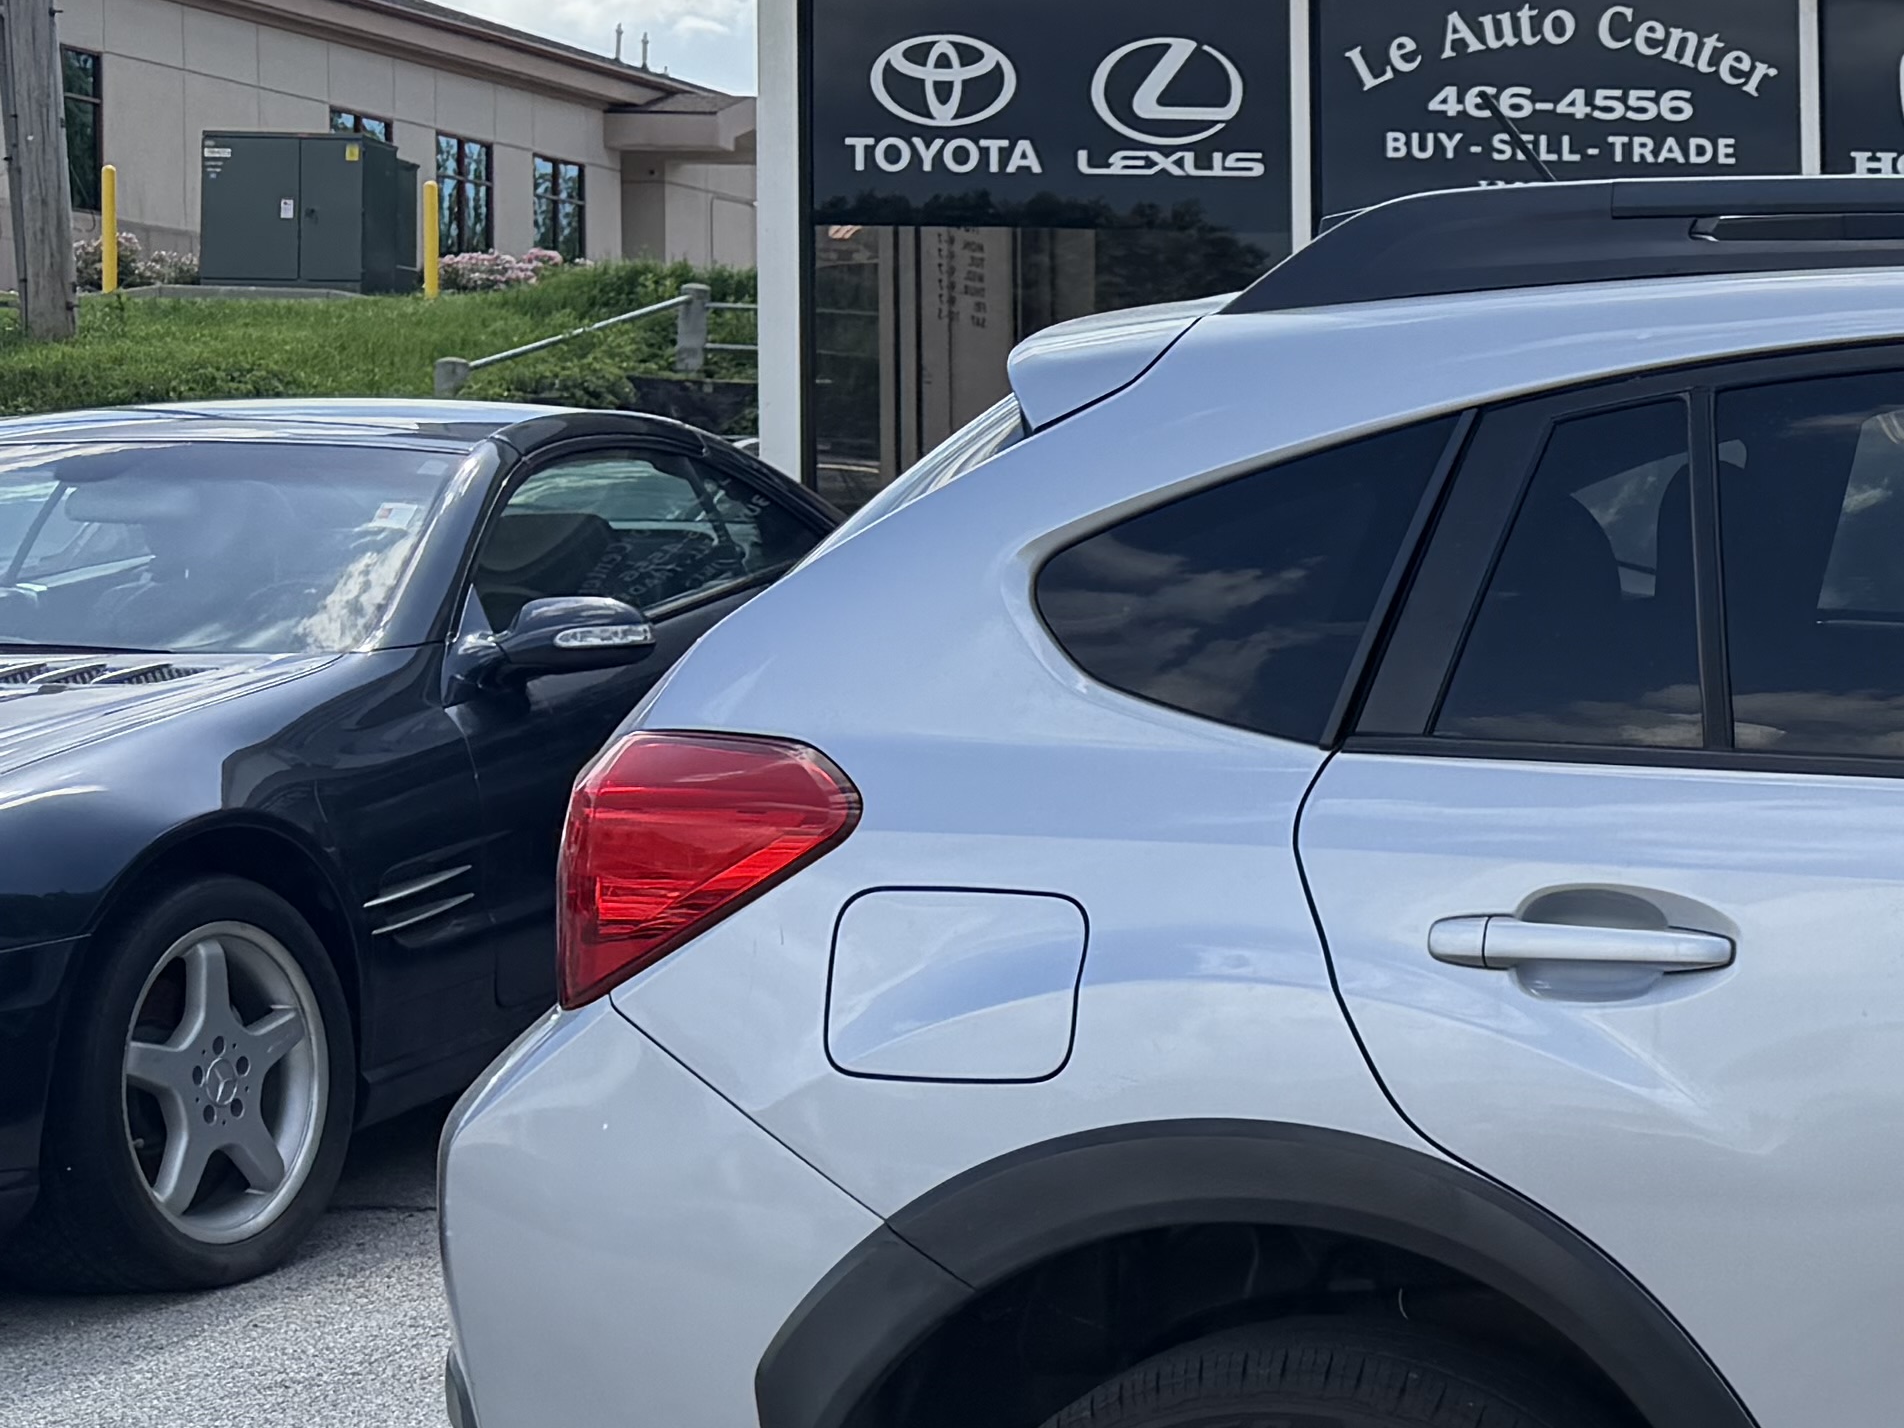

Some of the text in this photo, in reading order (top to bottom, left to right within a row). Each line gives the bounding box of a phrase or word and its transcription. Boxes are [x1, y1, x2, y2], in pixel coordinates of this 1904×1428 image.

[1344, 2, 1779, 98] Le Auto Center
[1427, 84, 1695, 122] 466-4556
[845, 137, 1042, 174] TOYOTA
[1076, 149, 1265, 177] LEXUS
[1384, 131, 1464, 160] BUY
[1607, 136, 1737, 166] TRADE
